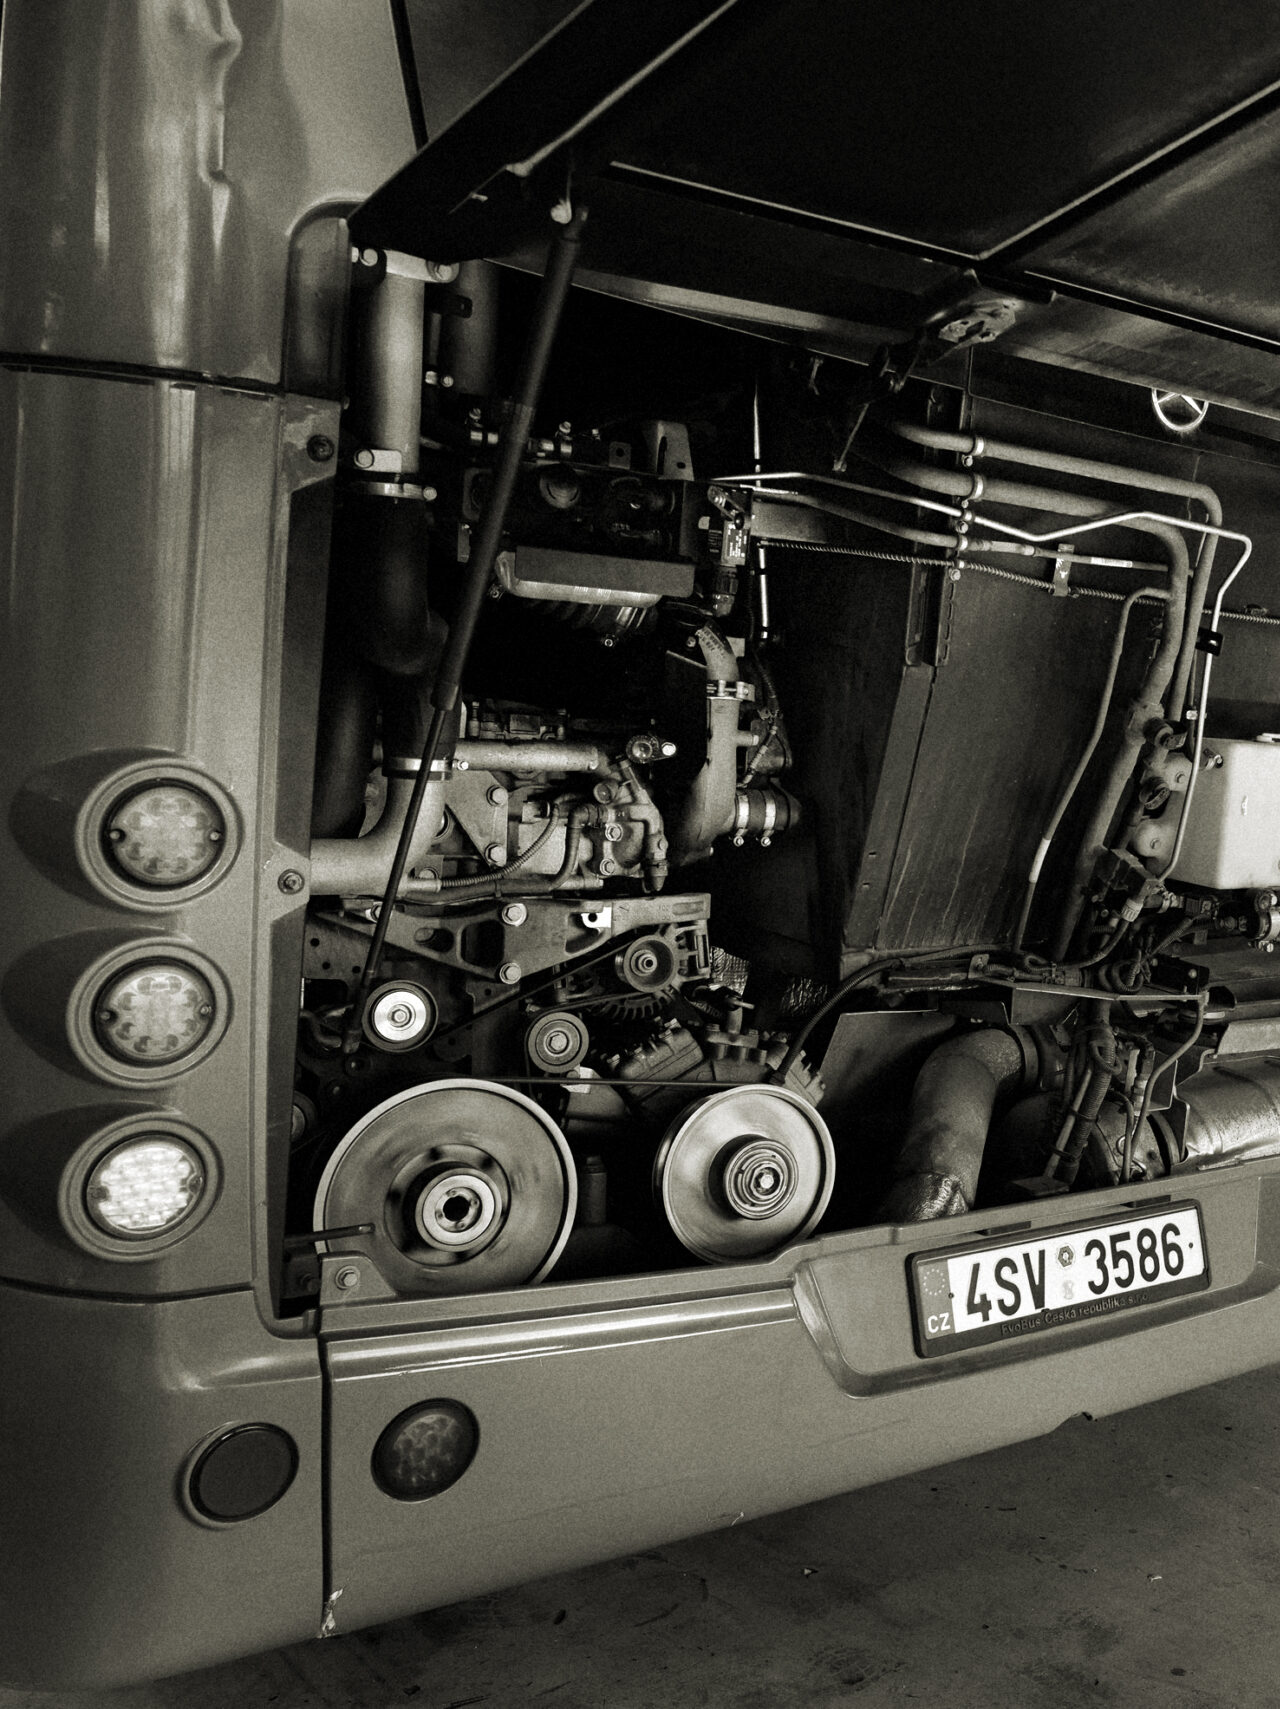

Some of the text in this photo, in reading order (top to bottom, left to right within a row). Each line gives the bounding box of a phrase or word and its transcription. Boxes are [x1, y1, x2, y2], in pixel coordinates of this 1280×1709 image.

[967, 1222, 1184, 1322] 4SV 3586
[928, 1311, 950, 1333] CZ
[1001, 1317, 1041, 1336] EvoBus
